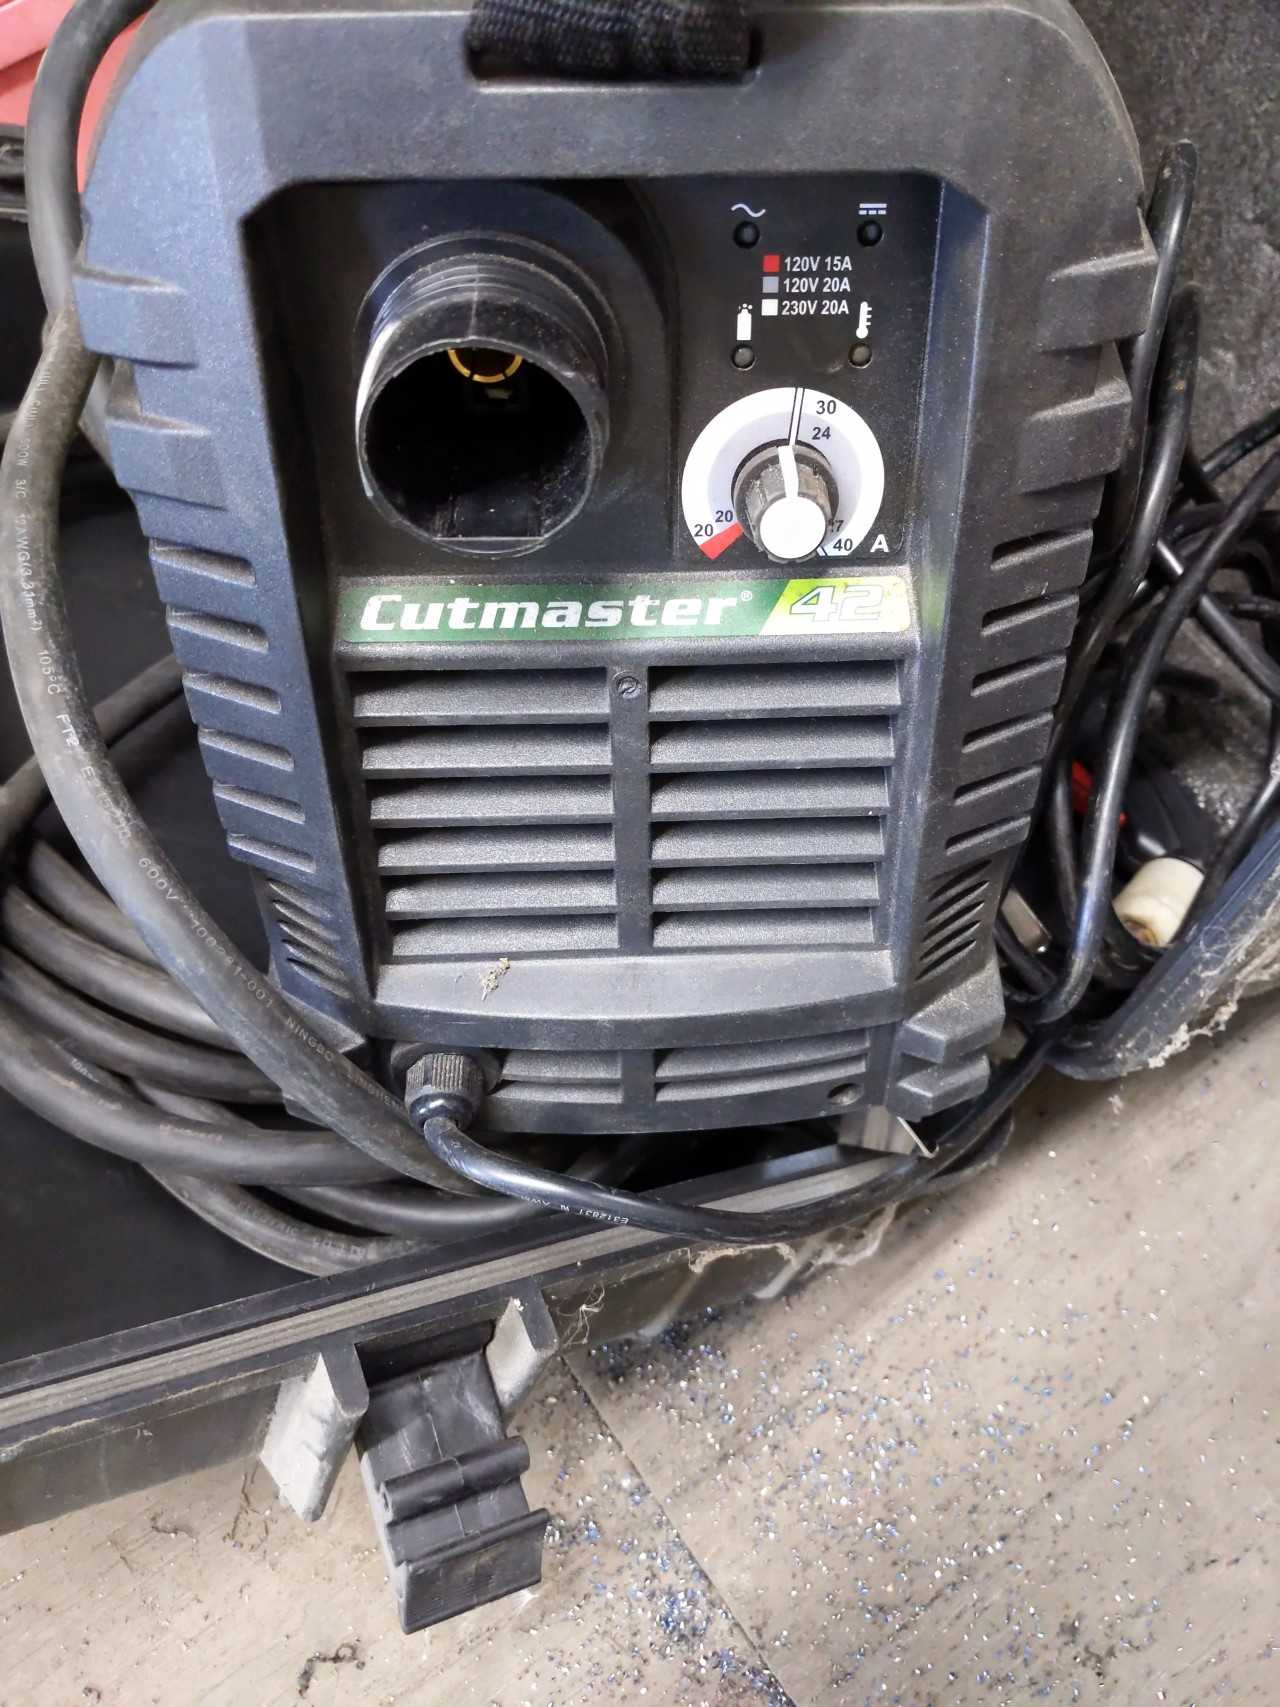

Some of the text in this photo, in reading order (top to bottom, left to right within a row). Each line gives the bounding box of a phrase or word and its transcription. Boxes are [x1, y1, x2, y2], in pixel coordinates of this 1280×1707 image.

[784, 255, 852, 272] 120V 15A
[783, 277, 851, 293] 120V 20A
[781, 299, 849, 315] 230V 20A
[815, 400, 837, 415] 30
[811, 426, 831, 440] 24
[715, 509, 734, 523] 20
[693, 523, 714, 537] 20
[831, 519, 845, 532] 7
[833, 538, 853, 552] 40
[870, 533, 889, 553] A
[789, 583, 884, 622] 42
[138, 857, 179, 900] 600V
